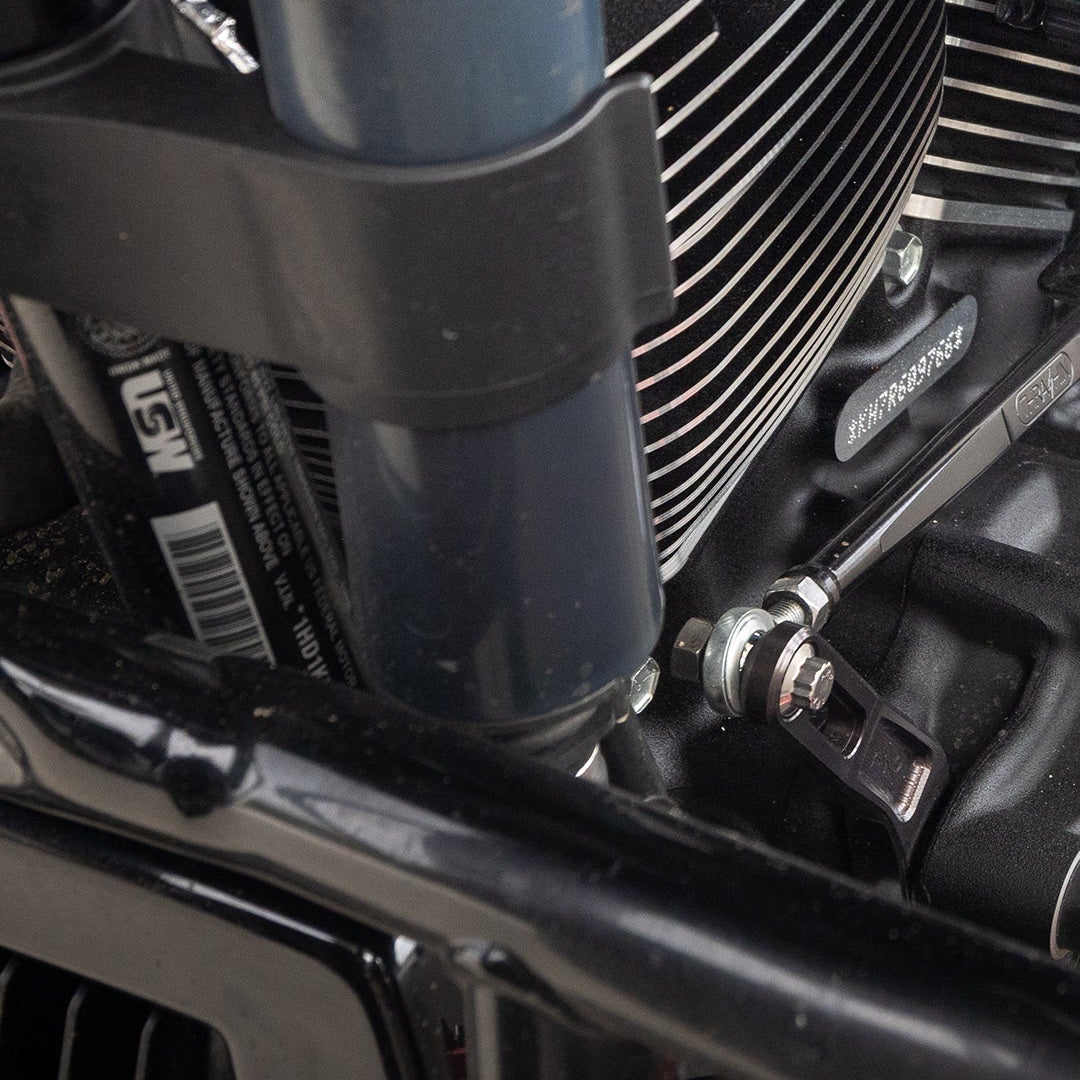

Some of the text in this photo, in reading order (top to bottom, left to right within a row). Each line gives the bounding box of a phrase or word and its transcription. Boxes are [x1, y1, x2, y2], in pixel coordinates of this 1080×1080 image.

[191, 358, 240, 470] MANUFACTURE
[230, 467, 261, 523] SHOWN
[250, 522, 279, 572] ABOVE
[217, 374, 258, 463] STANDARDS
[255, 478, 284, 533] EFFECT
